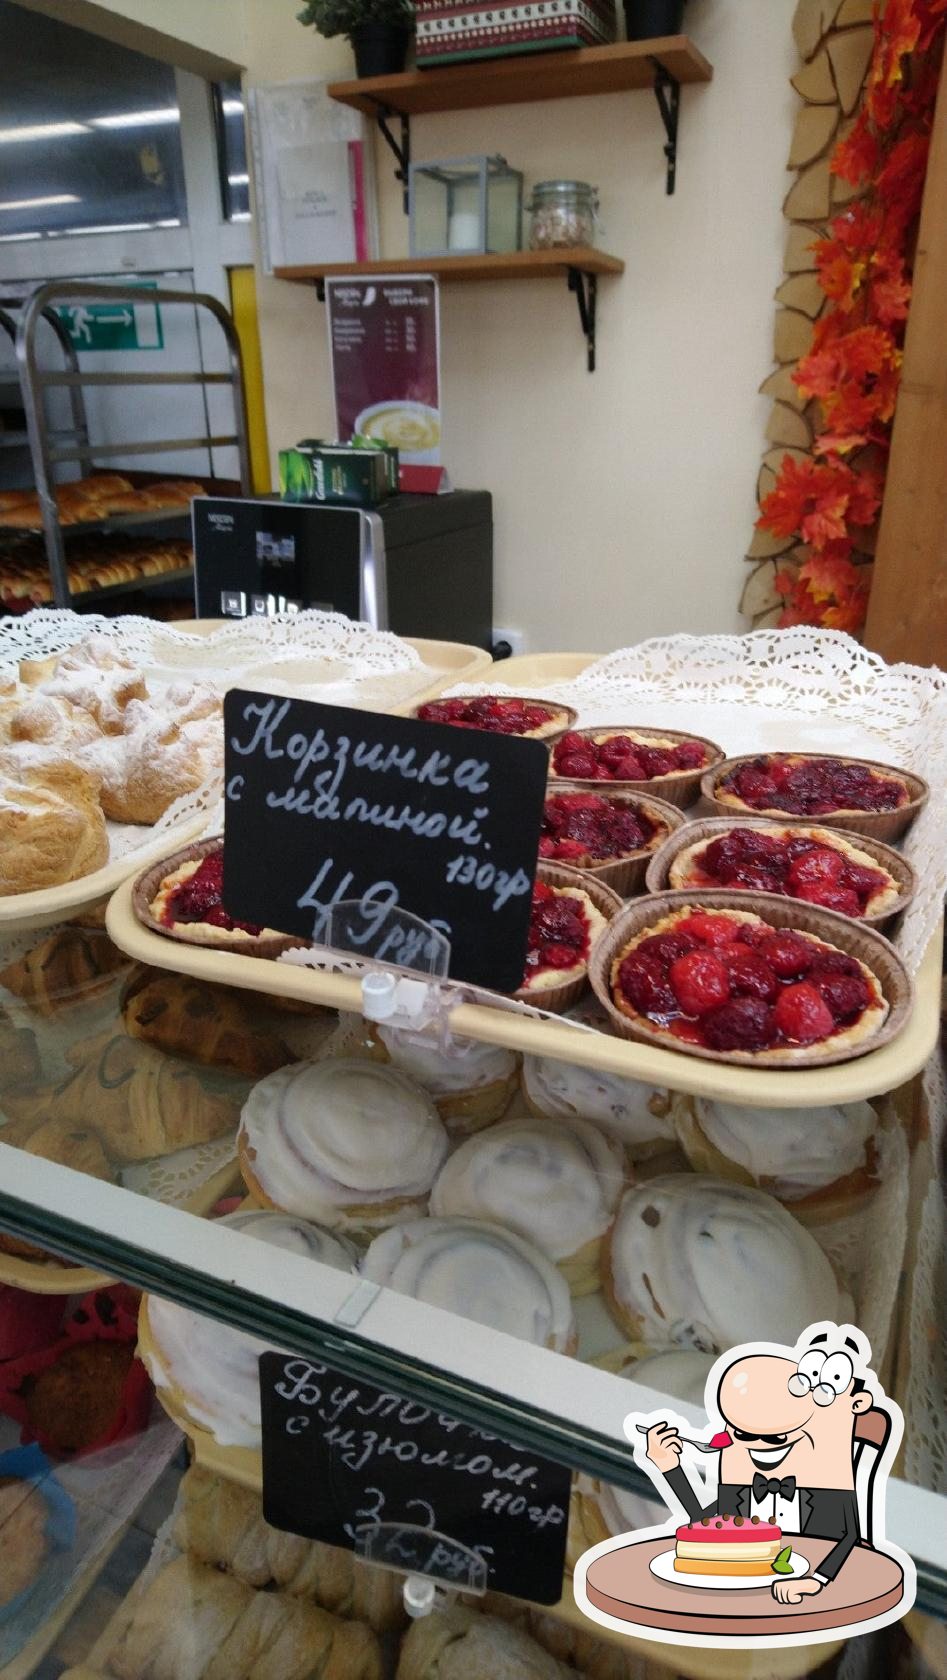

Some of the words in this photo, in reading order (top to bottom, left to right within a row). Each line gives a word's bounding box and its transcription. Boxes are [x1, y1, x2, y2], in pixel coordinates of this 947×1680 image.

[231, 699, 490, 794] Корзинка
[226, 774, 245, 801] с
[296, 857, 400, 944] 49
[286, 1414, 311, 1435] с
